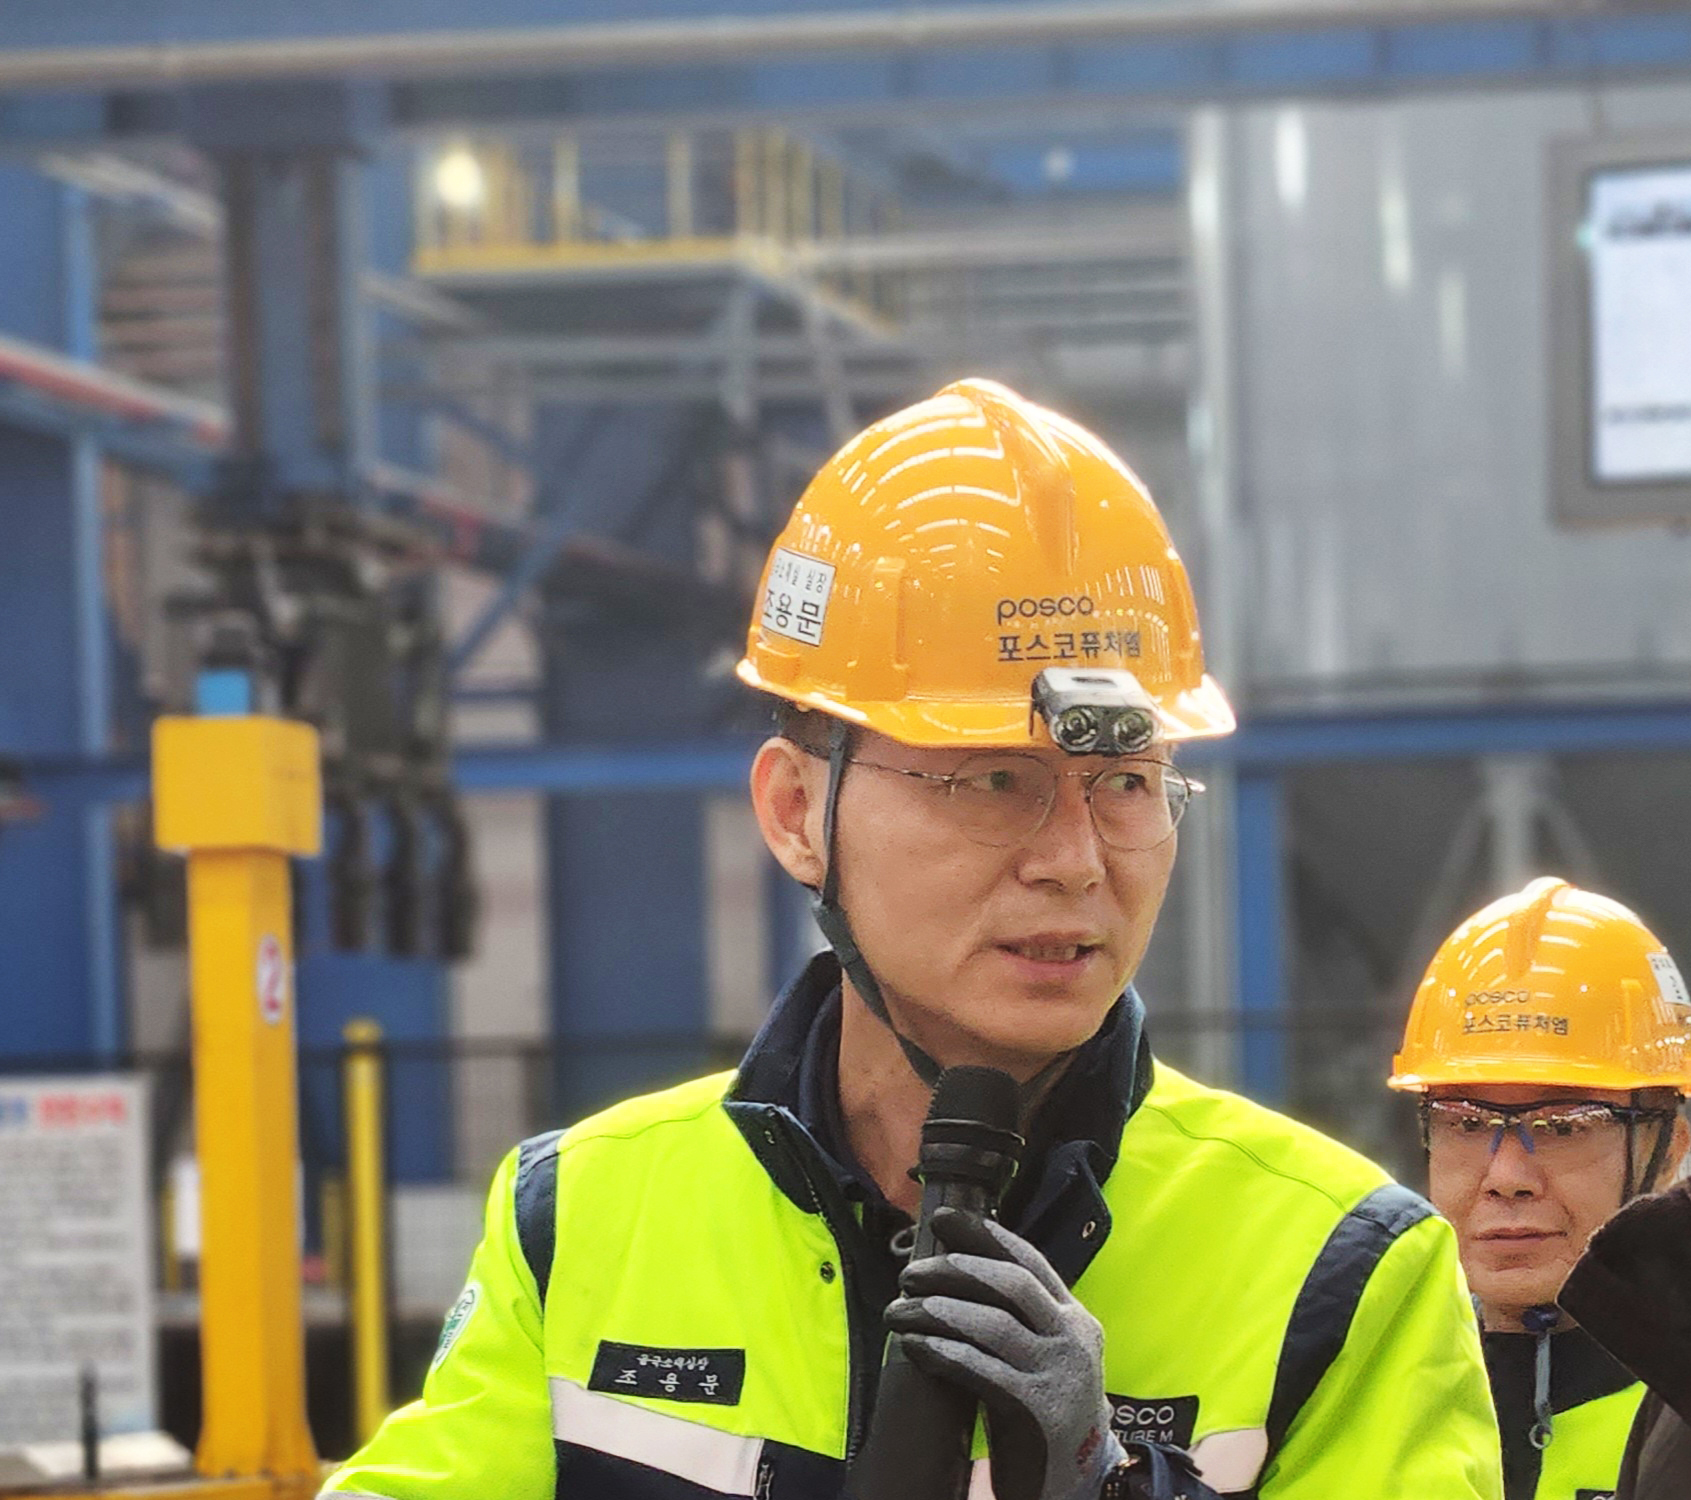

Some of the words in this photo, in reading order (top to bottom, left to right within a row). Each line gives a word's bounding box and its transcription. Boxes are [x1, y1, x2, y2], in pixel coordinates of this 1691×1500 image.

[997, 595, 1094, 626] posco
[997, 630, 1141, 662] 포스코퓨처엠
[1115, 1405, 1174, 1425] sco
[1114, 1429, 1156, 1443] TURE
